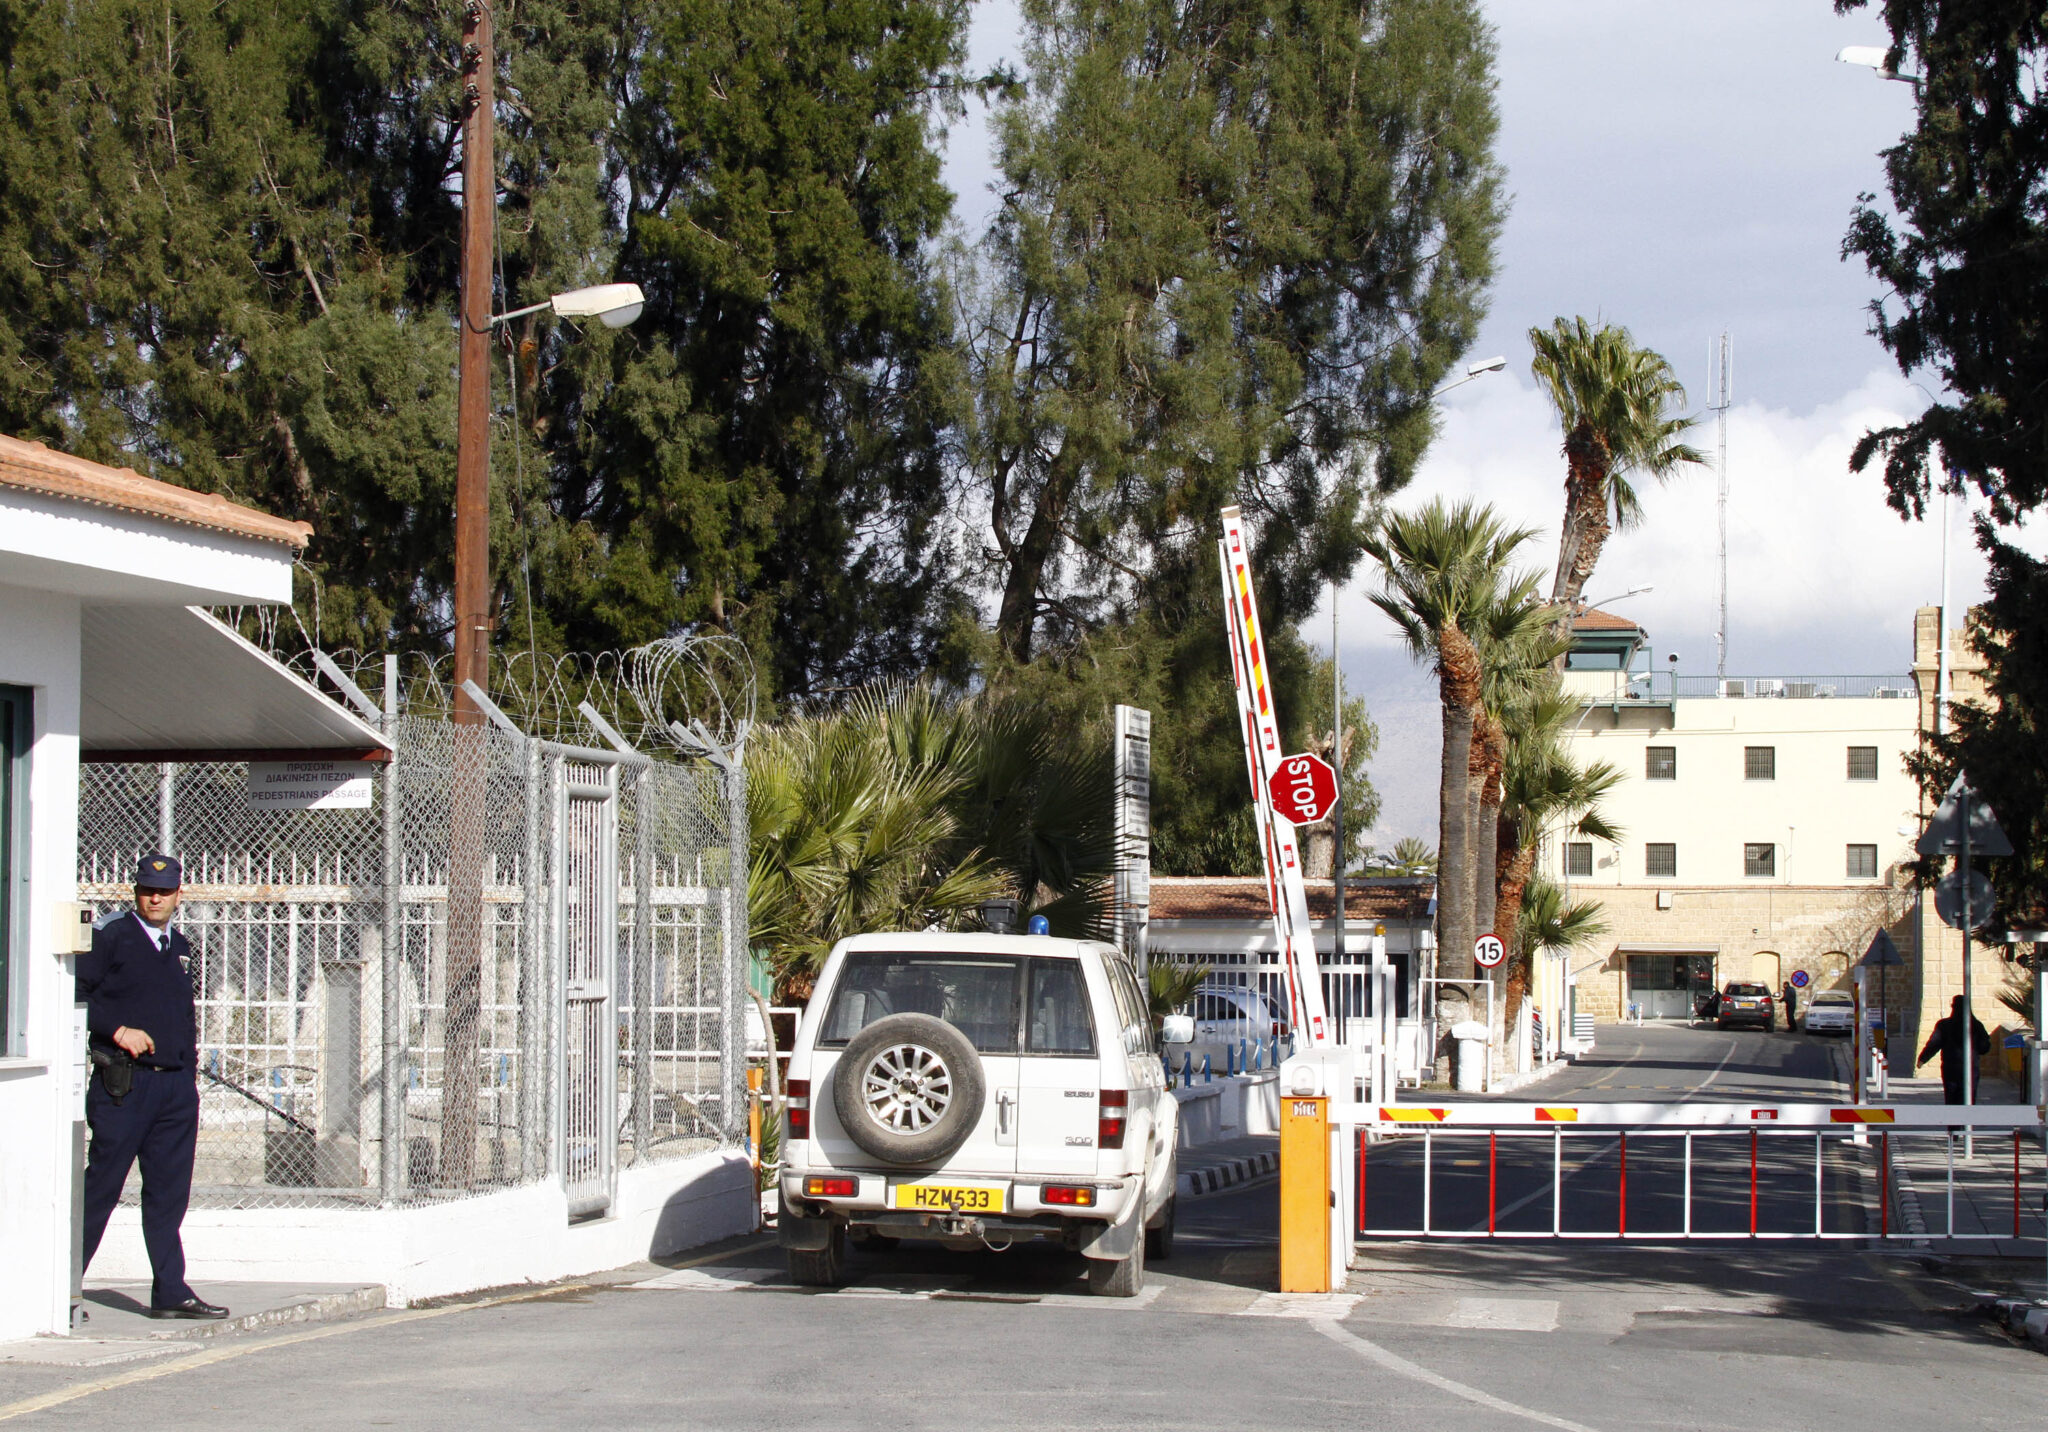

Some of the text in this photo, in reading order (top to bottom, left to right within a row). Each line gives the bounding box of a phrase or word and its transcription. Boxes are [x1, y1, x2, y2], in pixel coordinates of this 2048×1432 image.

[286, 762, 334, 772] ΠΡΟΣΟΧΗ
[265, 772, 355, 783] ΔΙΑΚΙΝΗΣΗ ΠΕΖΩΝ
[251, 789, 367, 800] PEDESTRIANS PASSAGE
[1288, 760, 1317, 817] STOP
[1477, 942, 1500, 961] 15
[915, 1188, 989, 1207] HZM533
